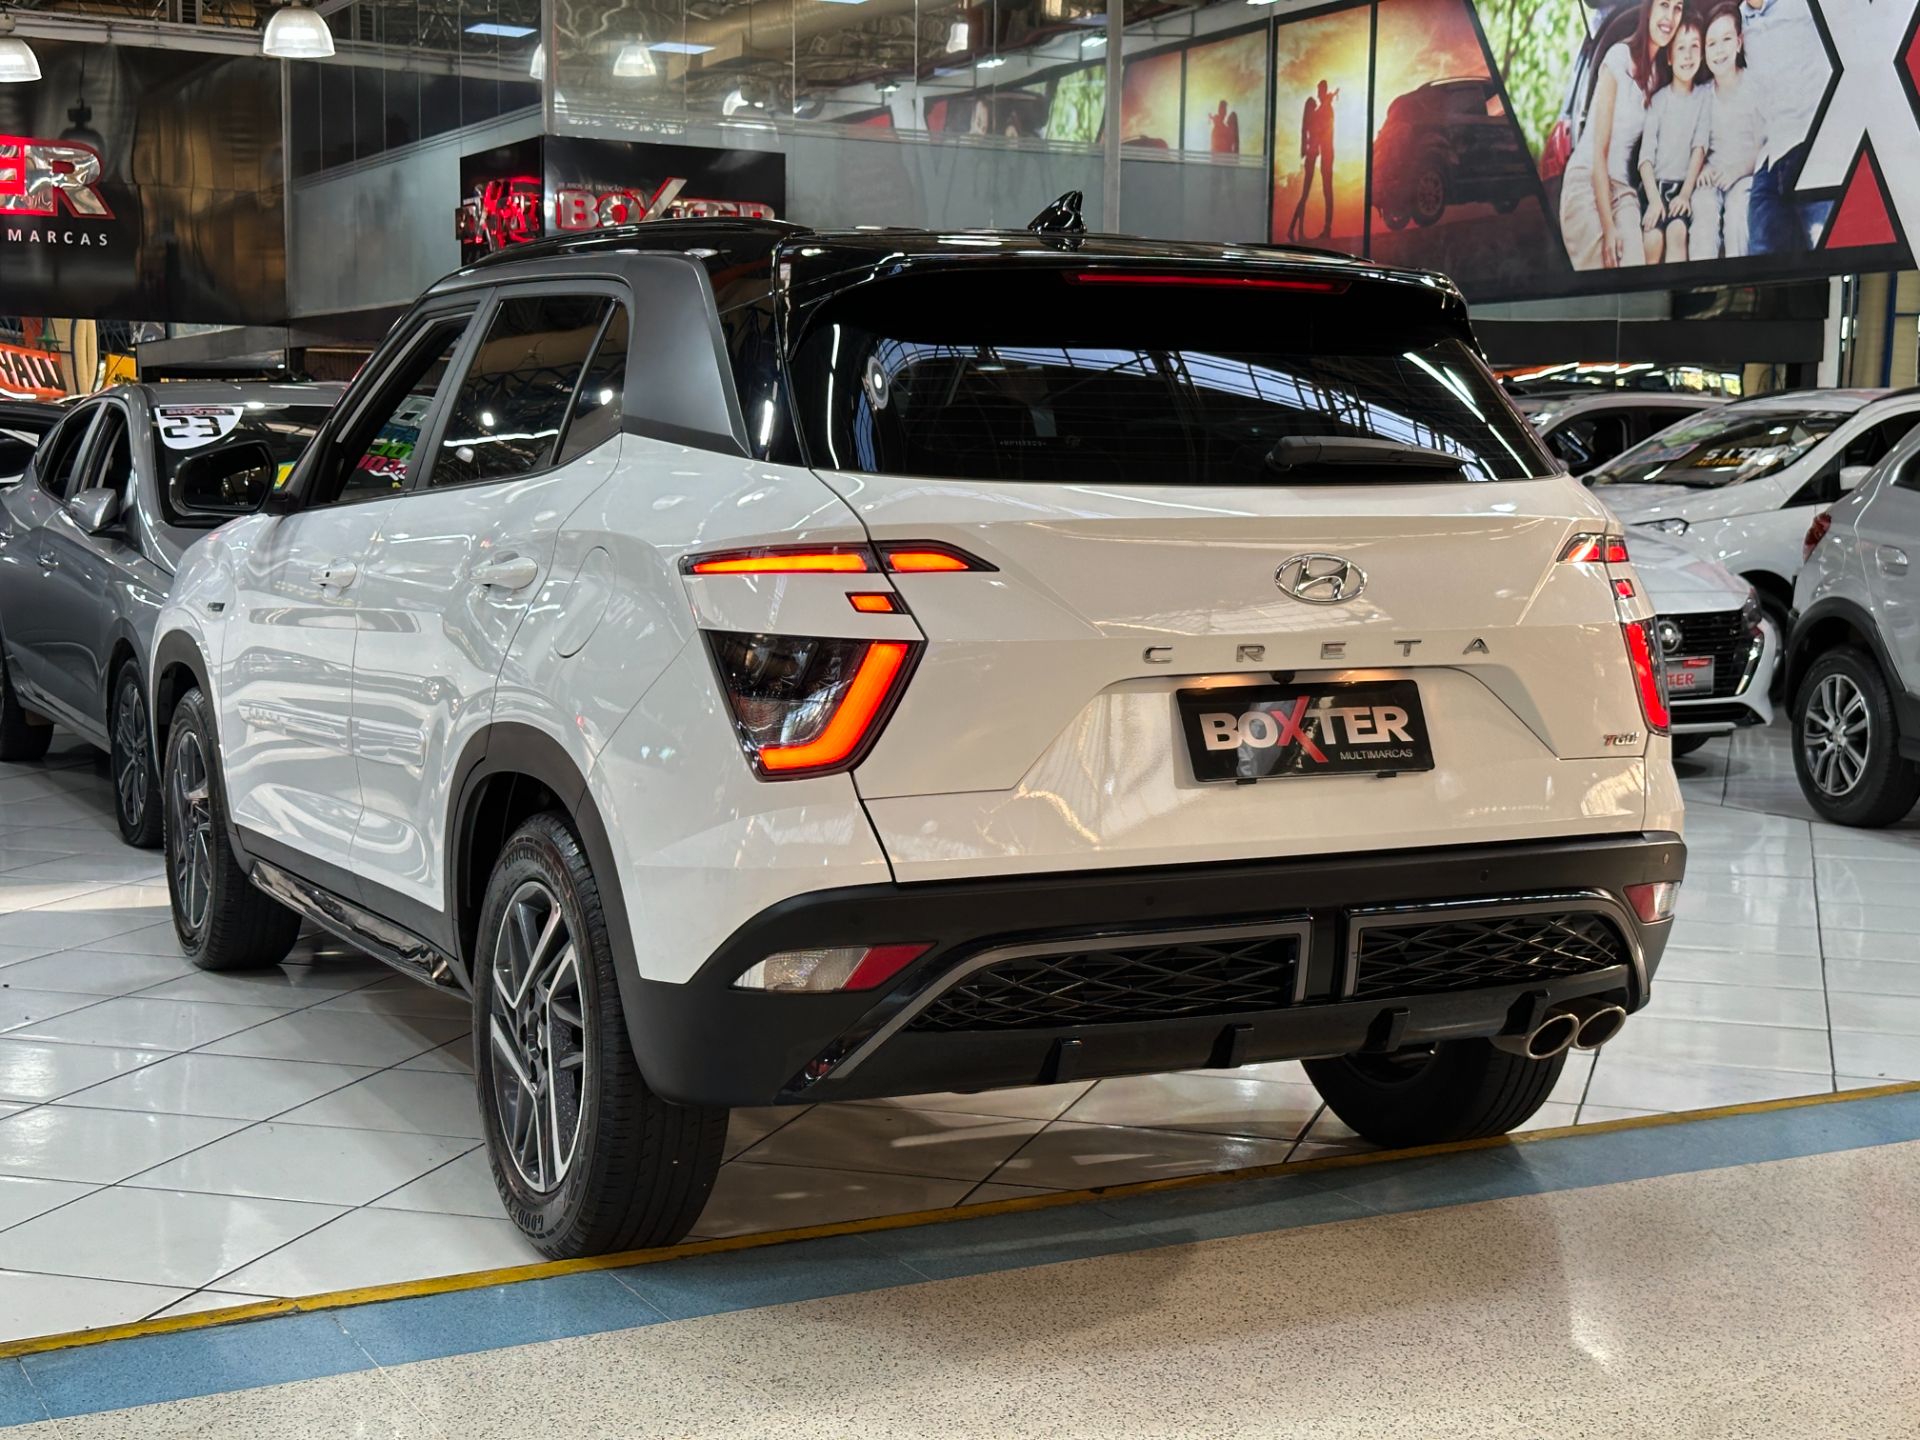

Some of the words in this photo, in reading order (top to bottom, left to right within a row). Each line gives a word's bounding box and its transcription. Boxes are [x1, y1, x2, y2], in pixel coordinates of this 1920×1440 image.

[8, 229, 108, 246] MARCAS
[163, 416, 222, 438] 23
[1143, 637, 1491, 665] CRETA
[1199, 696, 1414, 763] BOXTER
[1340, 749, 1413, 760] MULTIMARCAS
